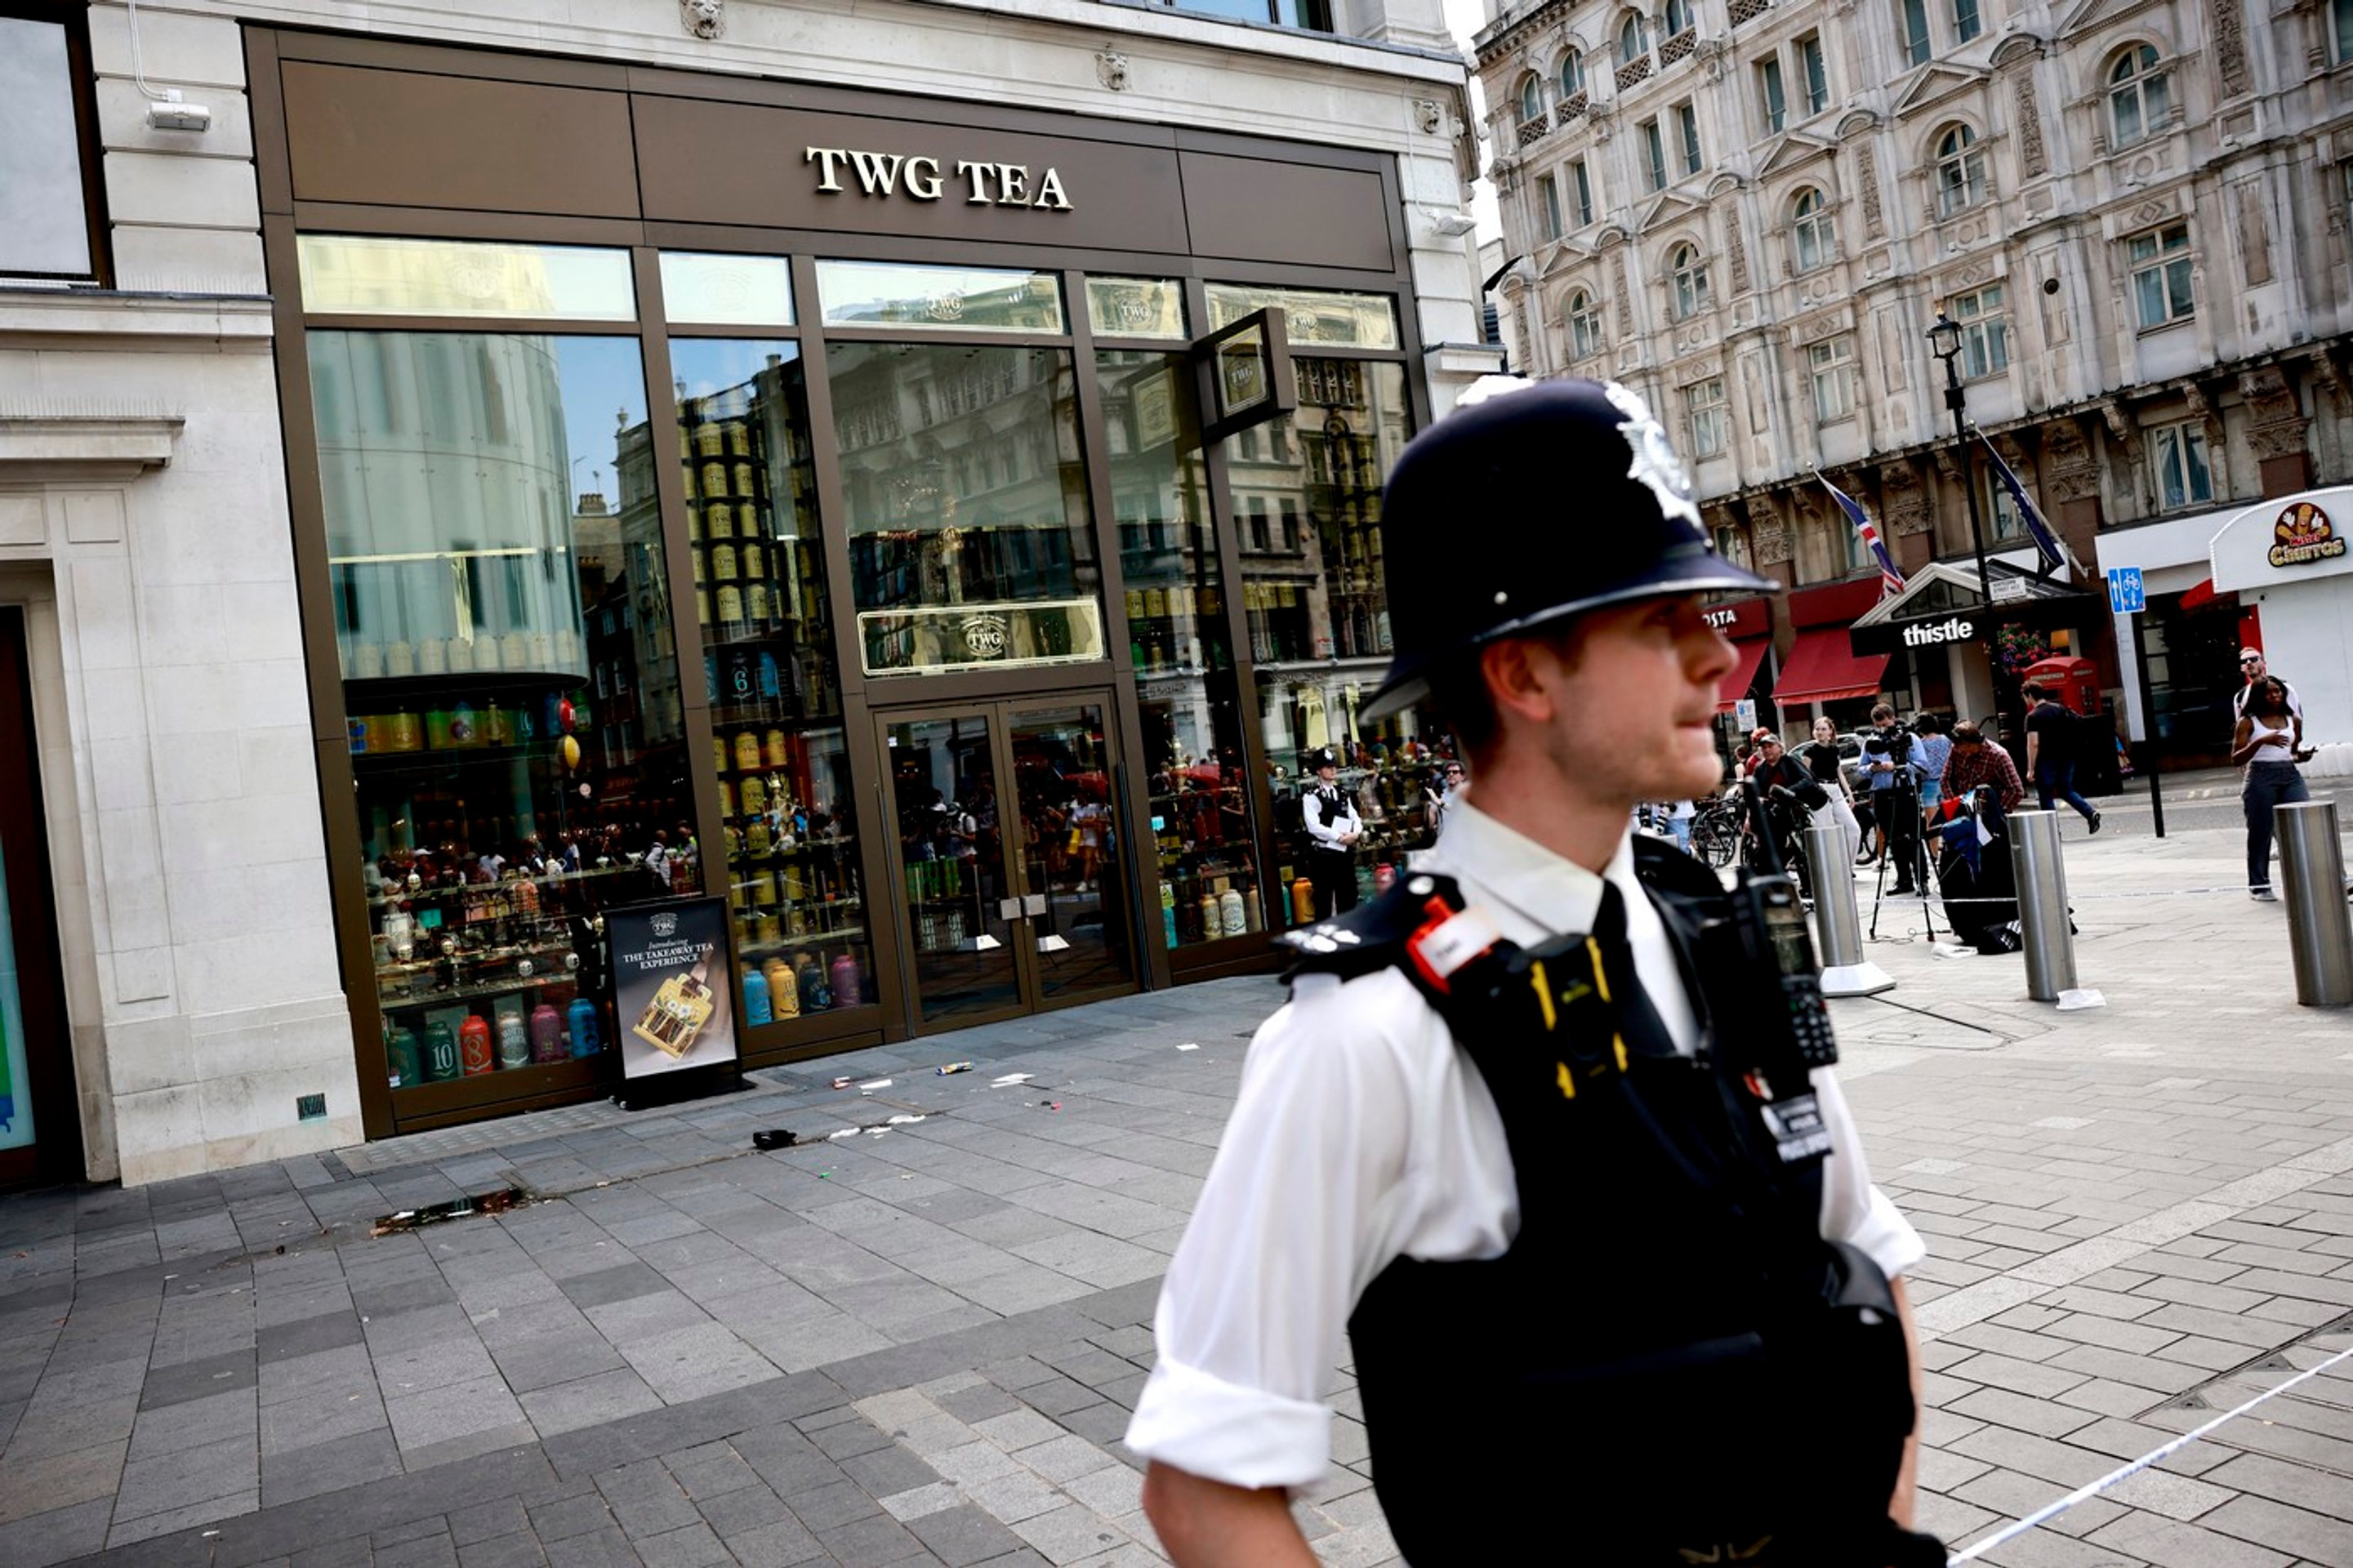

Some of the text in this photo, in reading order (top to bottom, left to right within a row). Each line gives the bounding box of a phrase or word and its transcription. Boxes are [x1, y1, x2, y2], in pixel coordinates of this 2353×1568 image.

[806, 146, 1074, 210] TWG TEA
[969, 632, 1000, 646] TWG
[1903, 617, 1973, 646] thistle
[734, 670, 748, 692] 6
[622, 942, 714, 963] THE TAKEAWAY TEA
[640, 954, 700, 970] EXPERIENCE
[432, 1044, 453, 1071] 10
